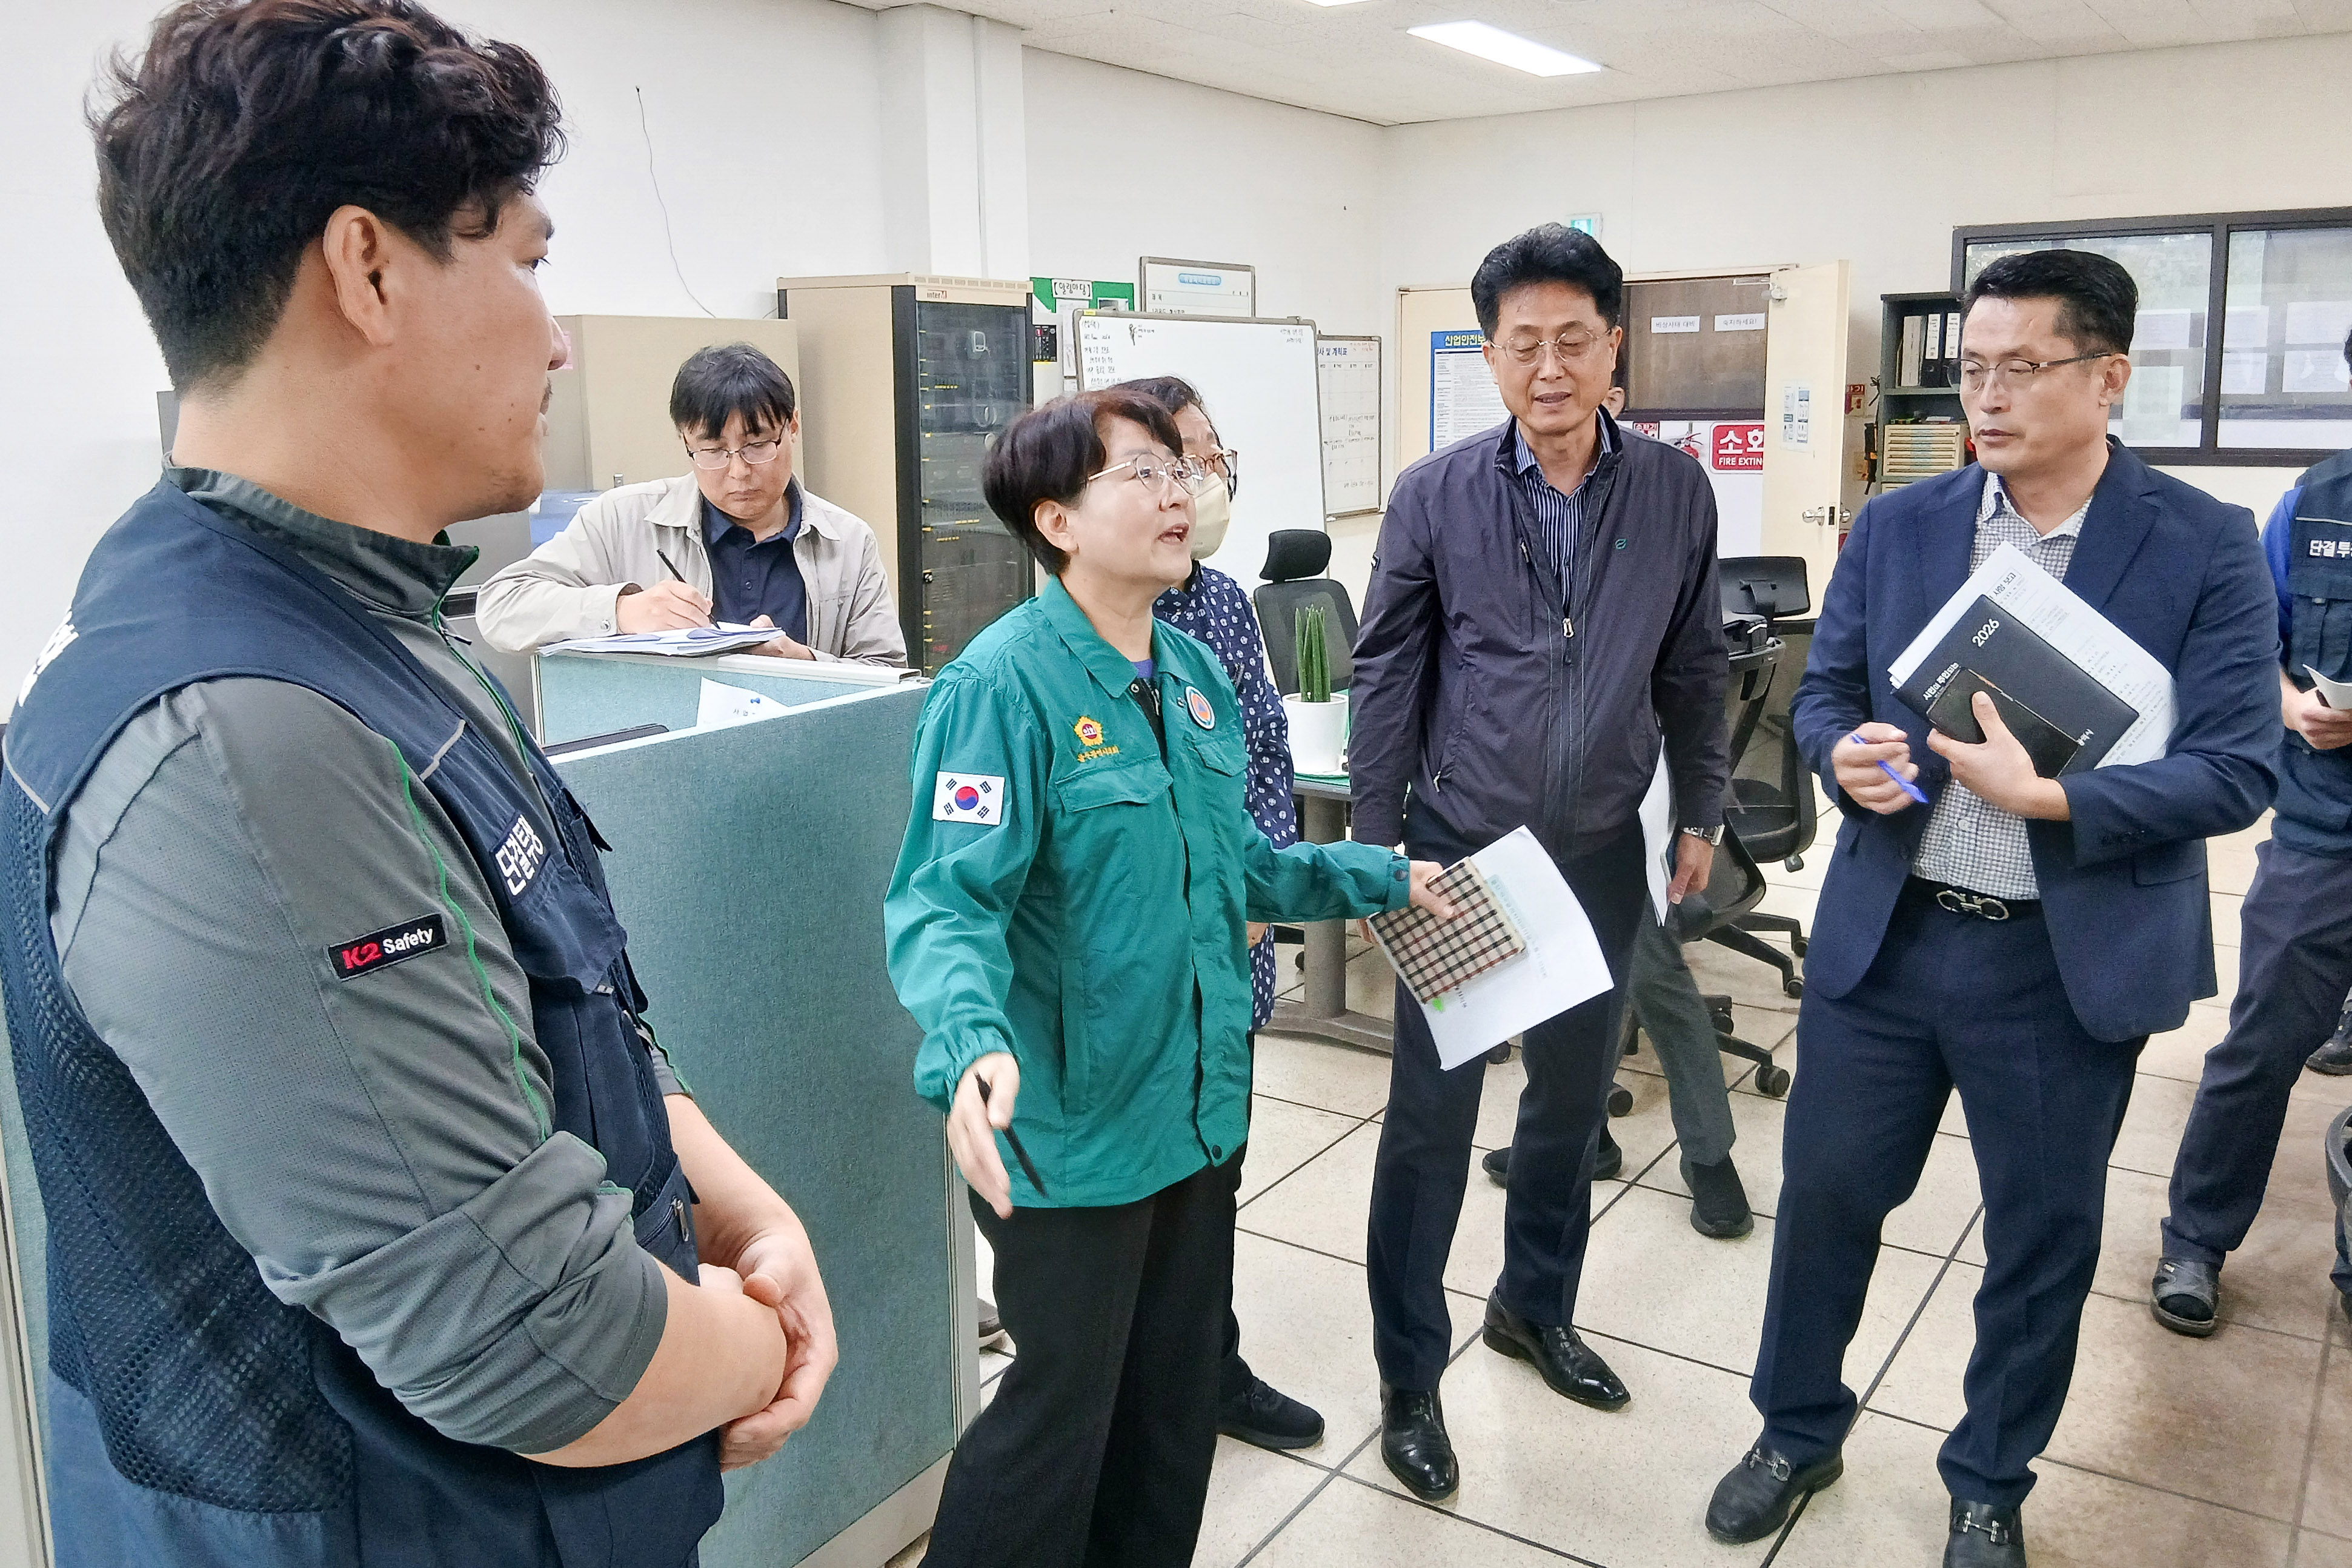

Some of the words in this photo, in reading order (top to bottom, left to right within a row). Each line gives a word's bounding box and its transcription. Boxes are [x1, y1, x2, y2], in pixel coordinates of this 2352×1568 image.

[1718, 457, 1736, 466] FIRE
[1972, 618, 2000, 647] 2026
[1922, 682, 1941, 700] 시민이
[1936, 662, 1959, 684] 주인되는
[341, 942, 383, 969] K2
[382, 928, 433, 954] Safety
